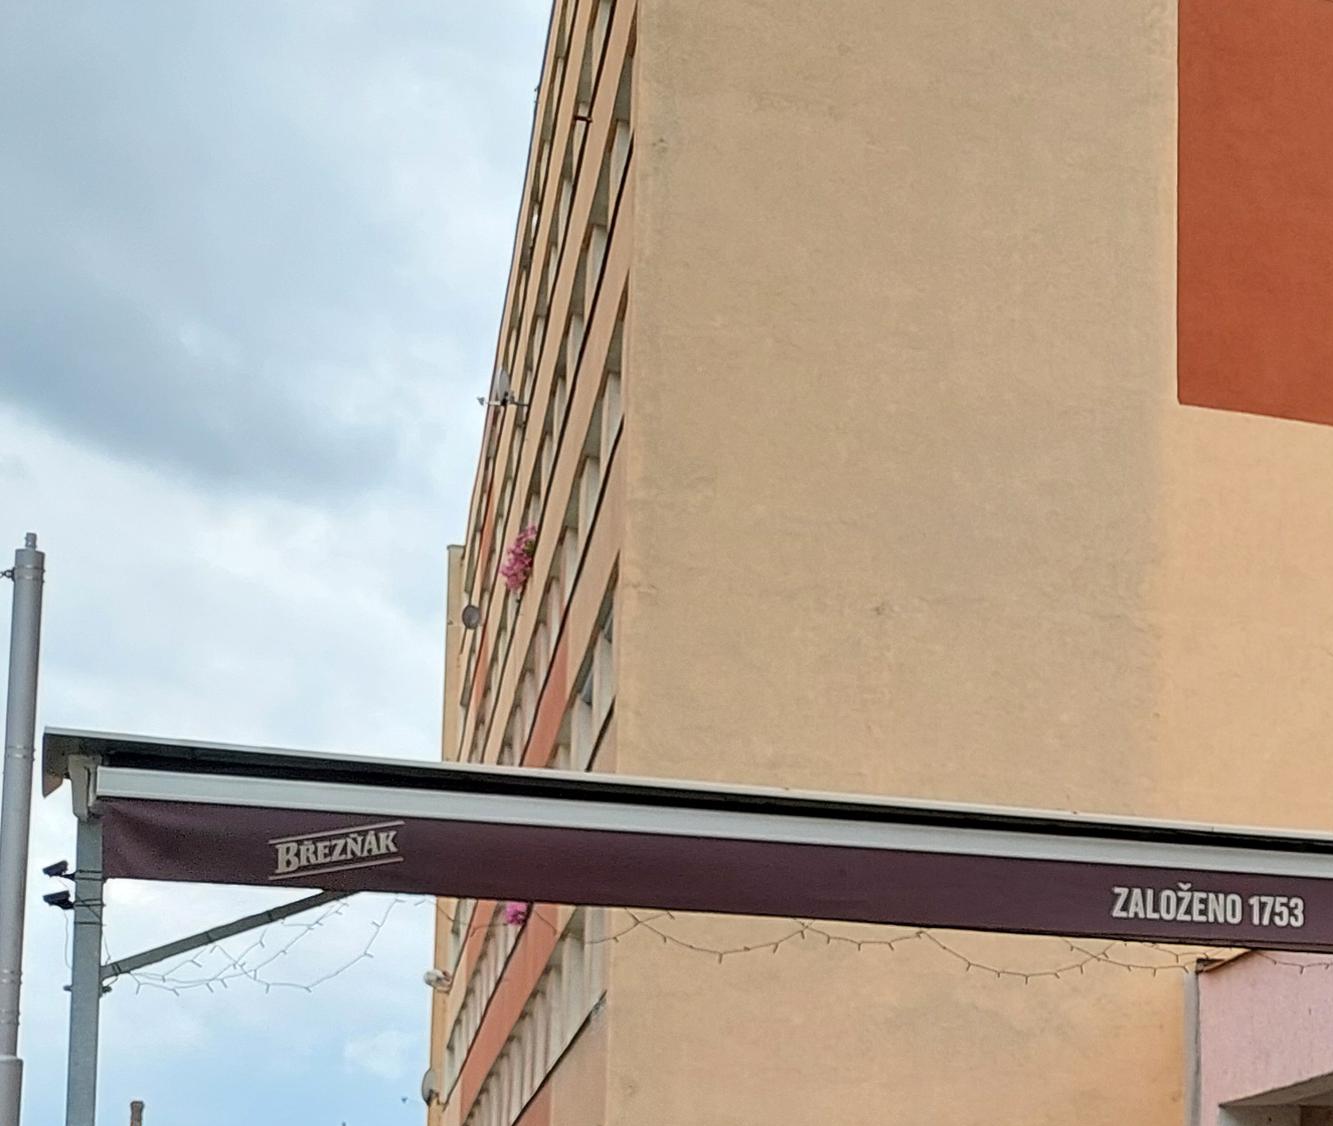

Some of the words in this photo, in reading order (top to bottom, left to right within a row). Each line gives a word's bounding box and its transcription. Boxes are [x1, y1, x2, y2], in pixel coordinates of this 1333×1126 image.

[274, 830, 398, 874] BŘEZŇÁK
[1112, 882, 1243, 924] ZALOŽENO
[1249, 895, 1305, 927] 1753
